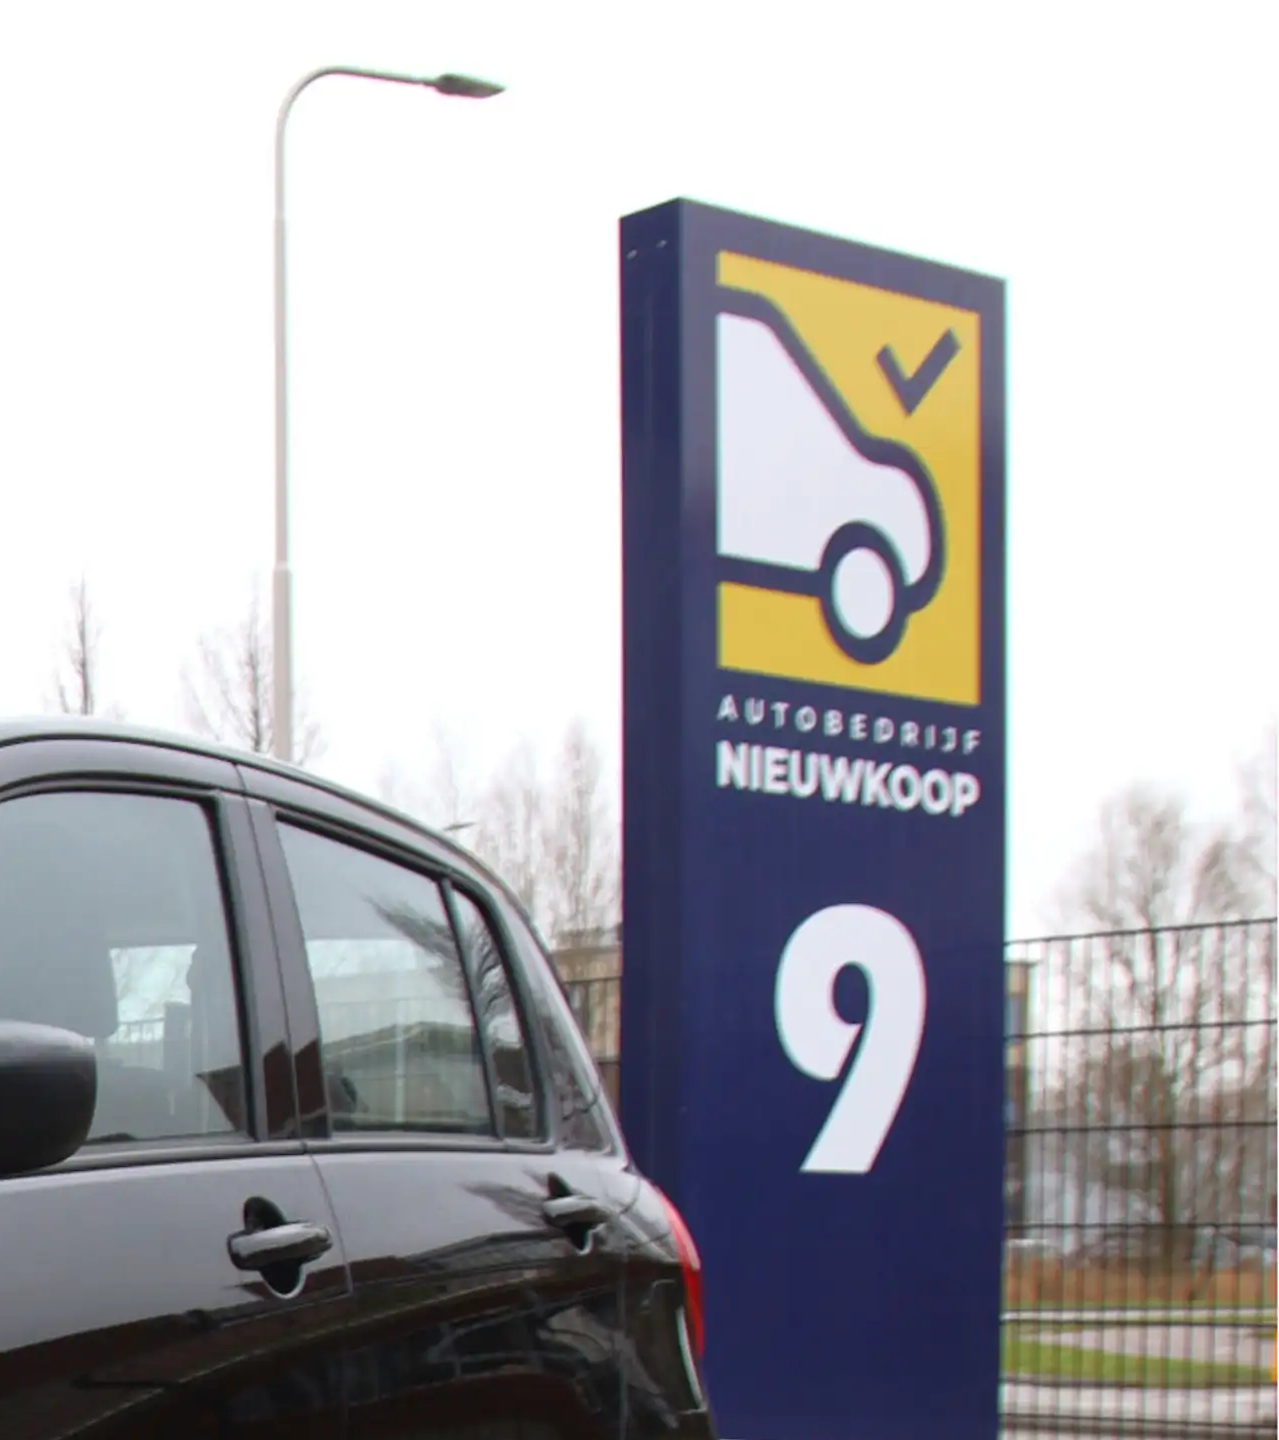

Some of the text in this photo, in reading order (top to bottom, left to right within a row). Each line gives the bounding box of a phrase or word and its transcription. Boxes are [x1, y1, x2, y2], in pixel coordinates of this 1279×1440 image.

[717, 694, 982, 755] AUTOBEDRIJF
[716, 739, 981, 817] NIEUWKOOP
[774, 902, 928, 1174] 9
